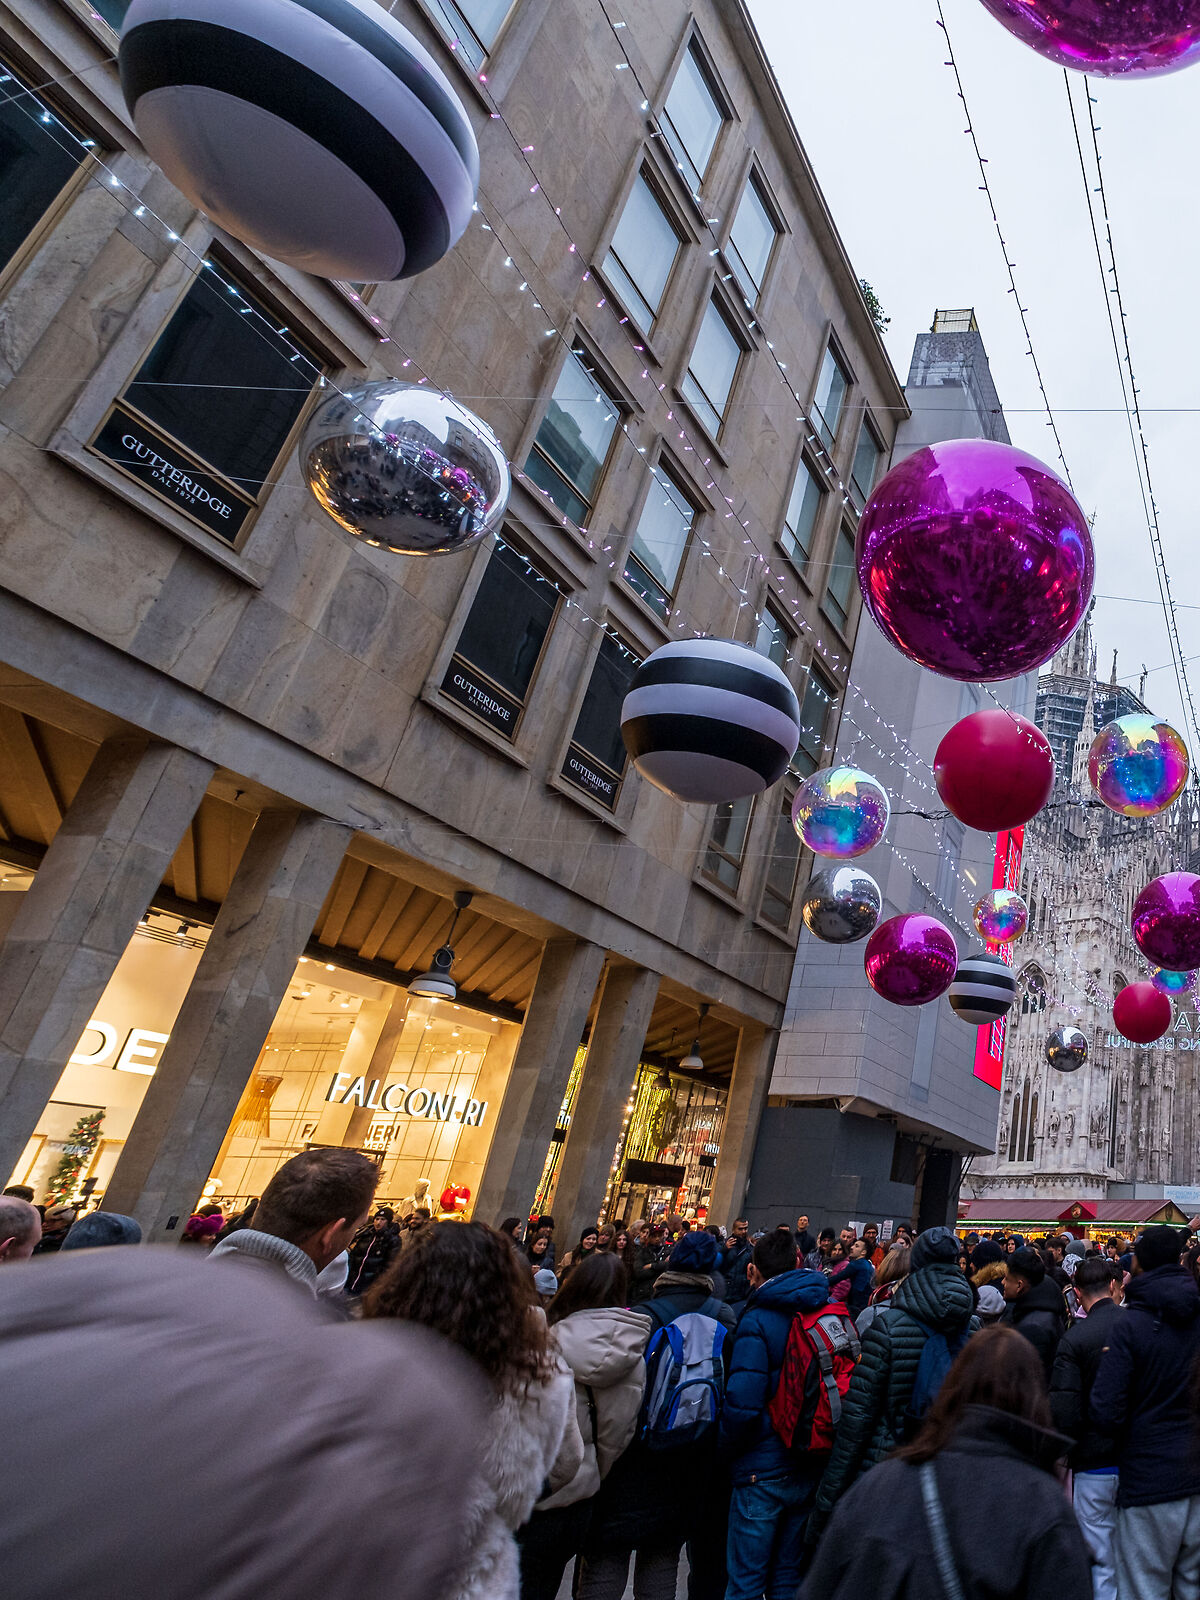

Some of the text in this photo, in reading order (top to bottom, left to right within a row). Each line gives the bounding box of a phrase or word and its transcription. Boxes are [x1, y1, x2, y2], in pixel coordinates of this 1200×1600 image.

[121, 434, 232, 519] GUTTERIDGE
[151, 470, 196, 504] DAL 1878
[453, 674, 511, 721] GUTTERIDGE
[569, 758, 612, 794] GUTTERIDGE
